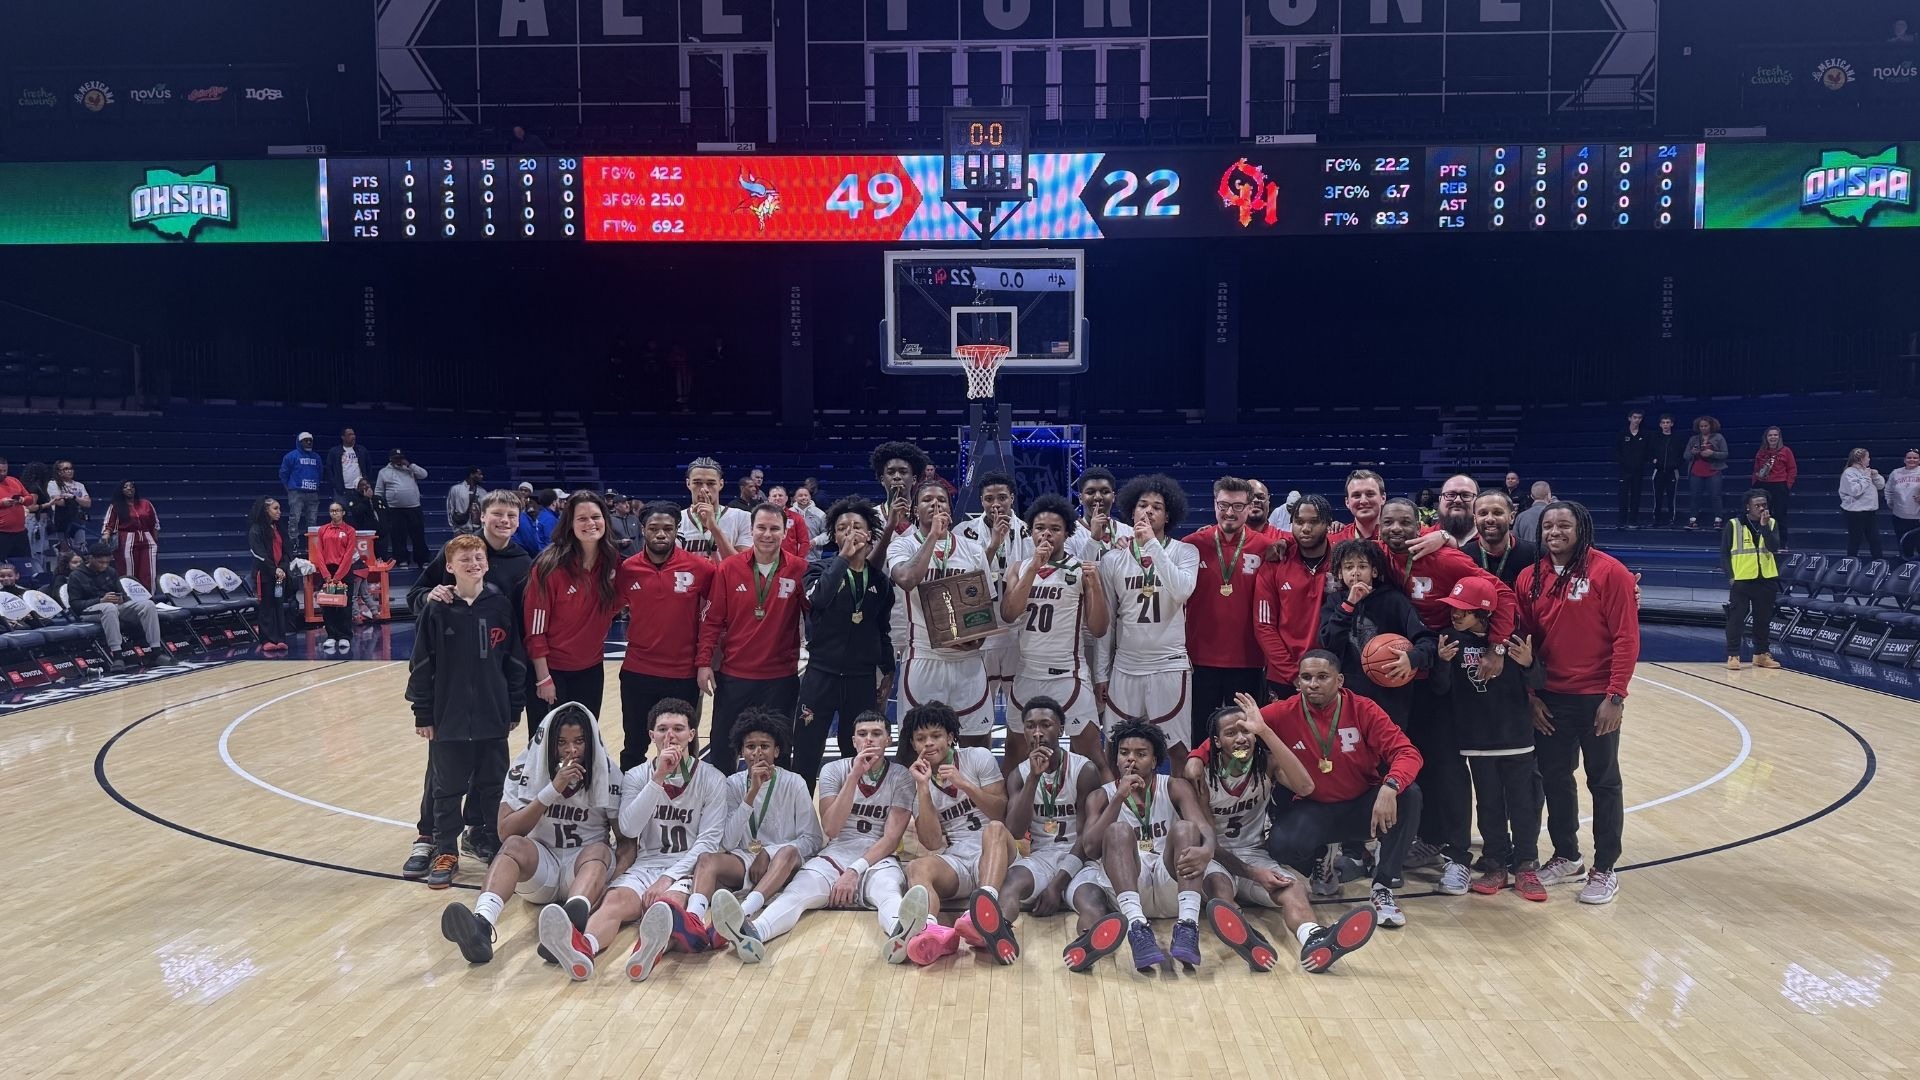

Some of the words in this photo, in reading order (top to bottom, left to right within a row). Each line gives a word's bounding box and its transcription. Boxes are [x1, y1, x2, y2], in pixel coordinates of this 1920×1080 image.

[1818, 58, 1856, 82] MEXICANA
[1873, 65, 1918, 80] novus
[130, 88, 171, 101] novus
[245, 88, 284, 100] noosa
[1257, 135, 1276, 143] 221
[305, 145, 323, 153] 219
[736, 143, 754, 151] 221
[1495, 147, 1505, 159] 0
[1536, 147, 1547, 158] 3
[1578, 146, 1589, 158] 4
[1619, 146, 1633, 157] 21
[1658, 145, 1678, 157] 24
[443, 159, 453, 171] 3
[481, 159, 495, 171] 15
[519, 159, 537, 171] 20
[558, 159, 576, 170] 30
[1325, 158, 1361, 172] FG%
[1375, 158, 1410, 171] 22.2
[1440, 165, 1467, 177] PTS
[1494, 163, 1505, 176] 0
[1536, 163, 1547, 175] 5
[1578, 162, 1589, 174] 0
[1620, 161, 1630, 173] 0
[1661, 161, 1672, 173] 0
[601, 166, 635, 180] FG%
[650, 166, 683, 180] 42.2
[352, 176, 379, 188] PTS
[404, 174, 415, 186] 0
[443, 174, 454, 186] 4
[483, 174, 494, 186] 0
[523, 174, 533, 186] 0
[563, 174, 574, 186] 0
[1440, 182, 1467, 194] REB
[1494, 180, 1505, 192] 0
[1536, 180, 1546, 192] 0
[1578, 179, 1588, 191] 0
[1620, 179, 1630, 191] 0
[1661, 178, 1672, 190] 0
[1806, 166, 1908, 203] OHSAA
[353, 193, 380, 205] REB
[406, 192, 413, 204] 1
[444, 191, 454, 203] 2
[484, 191, 494, 203] 0
[563, 191, 574, 203] 0
[826, 173, 904, 219] 49
[1103, 170, 1180, 217] 22
[1324, 185, 1370, 198] 3FG%
[1386, 184, 1410, 198] 6.7
[134, 184, 229, 219] OHSAA
[602, 193, 646, 207] 3FG%
[651, 193, 685, 207] 25.0
[1440, 199, 1467, 210] AST
[1494, 197, 1504, 209] 0
[1536, 196, 1546, 208] 0
[1577, 196, 1588, 208] 0
[1619, 196, 1630, 208] 0
[1661, 195, 1671, 207] 0
[354, 209, 380, 221] AST
[405, 208, 416, 221] 0
[445, 208, 455, 220] 0
[524, 208, 534, 219] 0
[564, 208, 575, 220] 0
[1324, 212, 1359, 226] FT%
[1375, 211, 1409, 225] 83.3
[1438, 216, 1465, 228] FLS
[1493, 214, 1504, 226] 0
[1535, 213, 1545, 226] 0
[1577, 213, 1587, 225] 0
[1619, 212, 1629, 224] 0
[1660, 212, 1671, 224] 0
[354, 225, 379, 237] FLS
[406, 224, 416, 236] 0
[445, 224, 456, 236] 0
[485, 224, 496, 236] 0
[525, 224, 535, 236] 0
[565, 224, 575, 236] 0
[603, 220, 637, 233] FT%
[652, 220, 685, 233] 69.2
[1242, 553, 1261, 574] P
[1837, 559, 1853, 571] X
[1866, 561, 1882, 575] X
[1900, 563, 1917, 577] X
[674, 572, 695, 593] P
[778, 578, 797, 599] P
[1412, 577, 1433, 599] P
[1137, 592, 1161, 623] 21
[1025, 603, 1054, 632] 20
[1769, 621, 1786, 631] ENIX
[1793, 626, 1816, 636] FENIX
[1818, 629, 1841, 641] FENIX
[1851, 635, 1877, 647] FENIX
[1884, 643, 1914, 652] FENIX
[54, 661, 74, 670] TOYOTA
[21, 669, 43, 678] TOYOTA
[1338, 727, 1360, 753] P
[652, 804, 694, 824] IKINGS
[851, 803, 890, 819] KINGS
[856, 820, 872, 833] 0
[1225, 816, 1244, 838] 5
[552, 823, 583, 848] 15
[659, 824, 688, 854] 10
